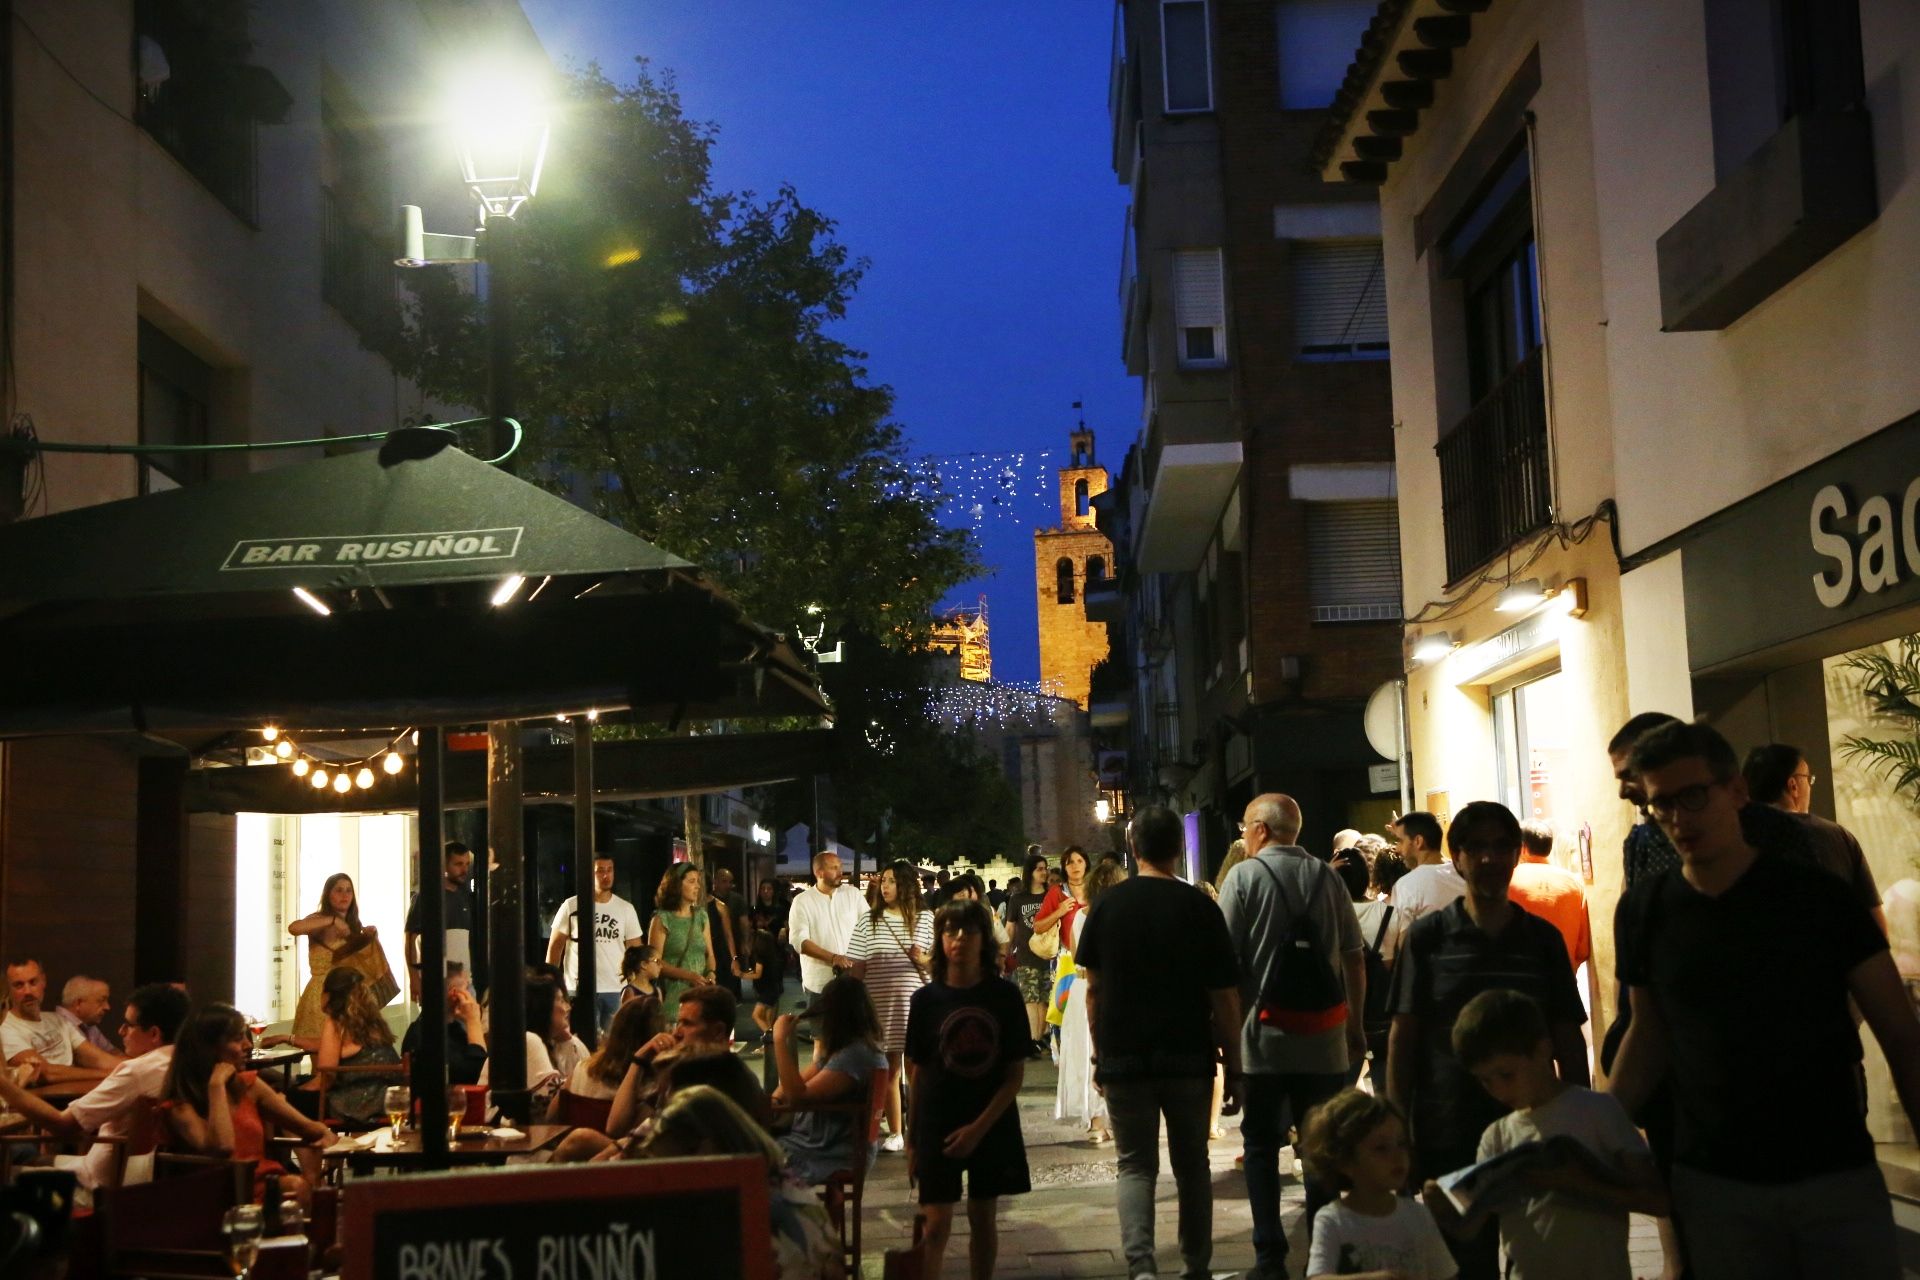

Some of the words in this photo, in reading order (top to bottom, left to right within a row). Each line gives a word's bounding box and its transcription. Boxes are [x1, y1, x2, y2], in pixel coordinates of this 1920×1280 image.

[241, 544, 321, 564] BAR
[335, 535, 502, 561] RUSIÑOL
[593, 912, 619, 930] EPE
[595, 927, 620, 939] ANS
